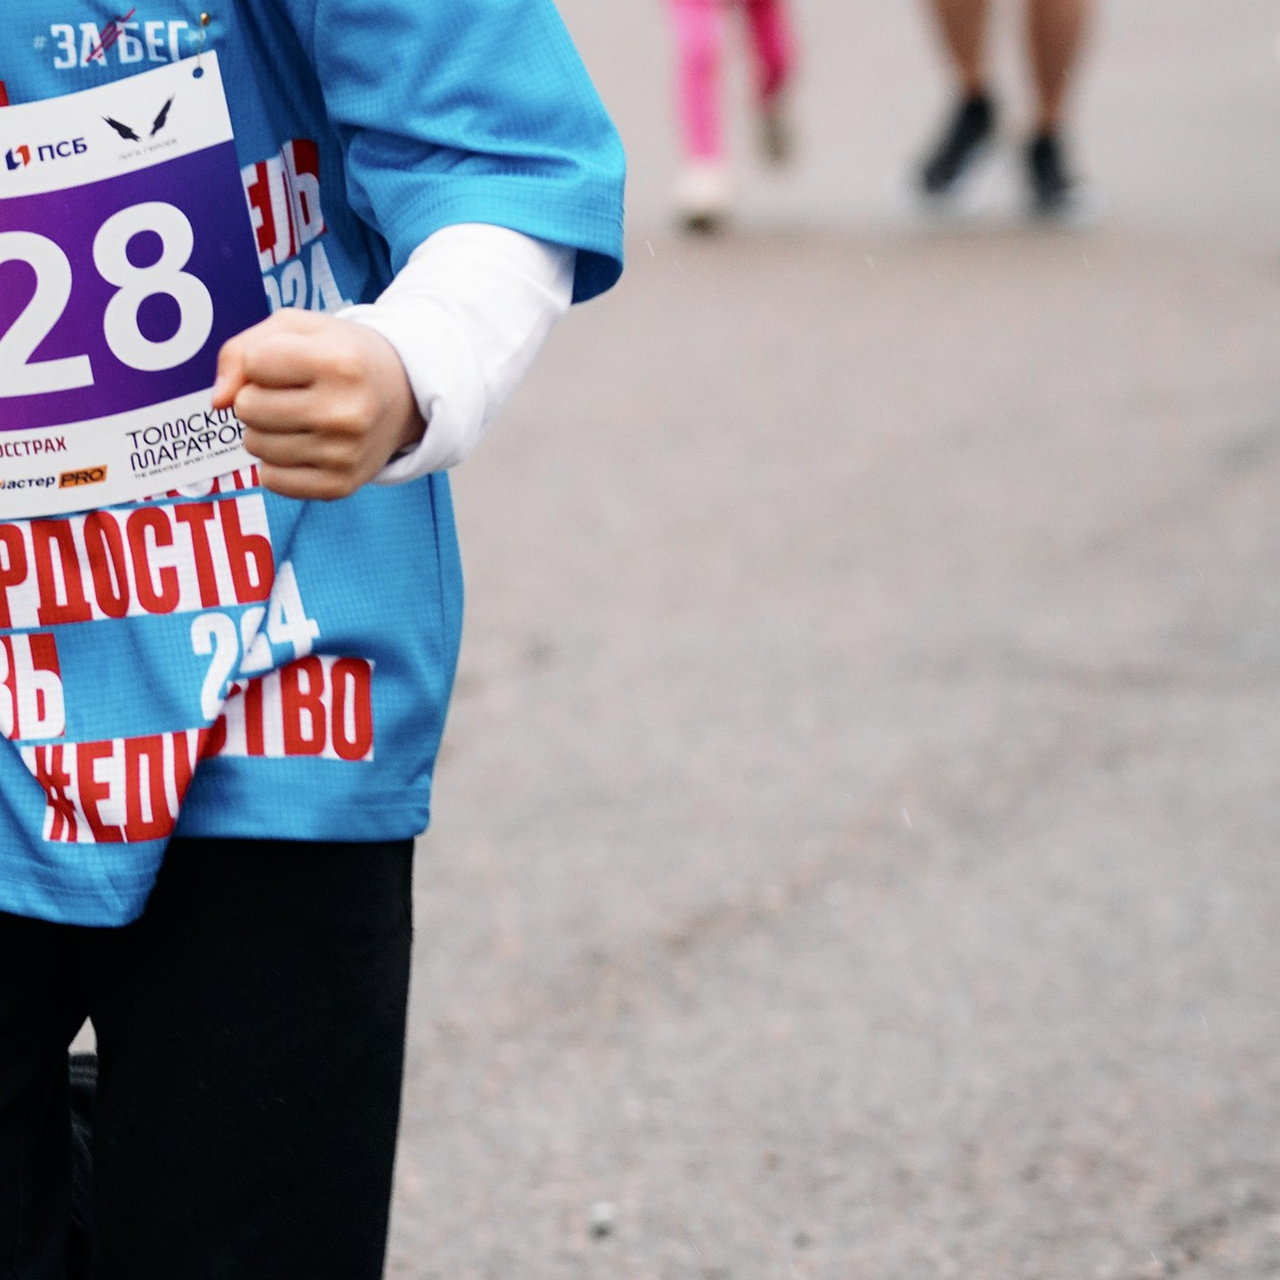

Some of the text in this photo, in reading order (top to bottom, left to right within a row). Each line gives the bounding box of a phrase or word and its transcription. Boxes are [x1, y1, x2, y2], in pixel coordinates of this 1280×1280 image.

[37, 137, 88, 162] ПСБ
[125, 406, 238, 450] ТОМСКИ
[60, 467, 104, 487] PRO
